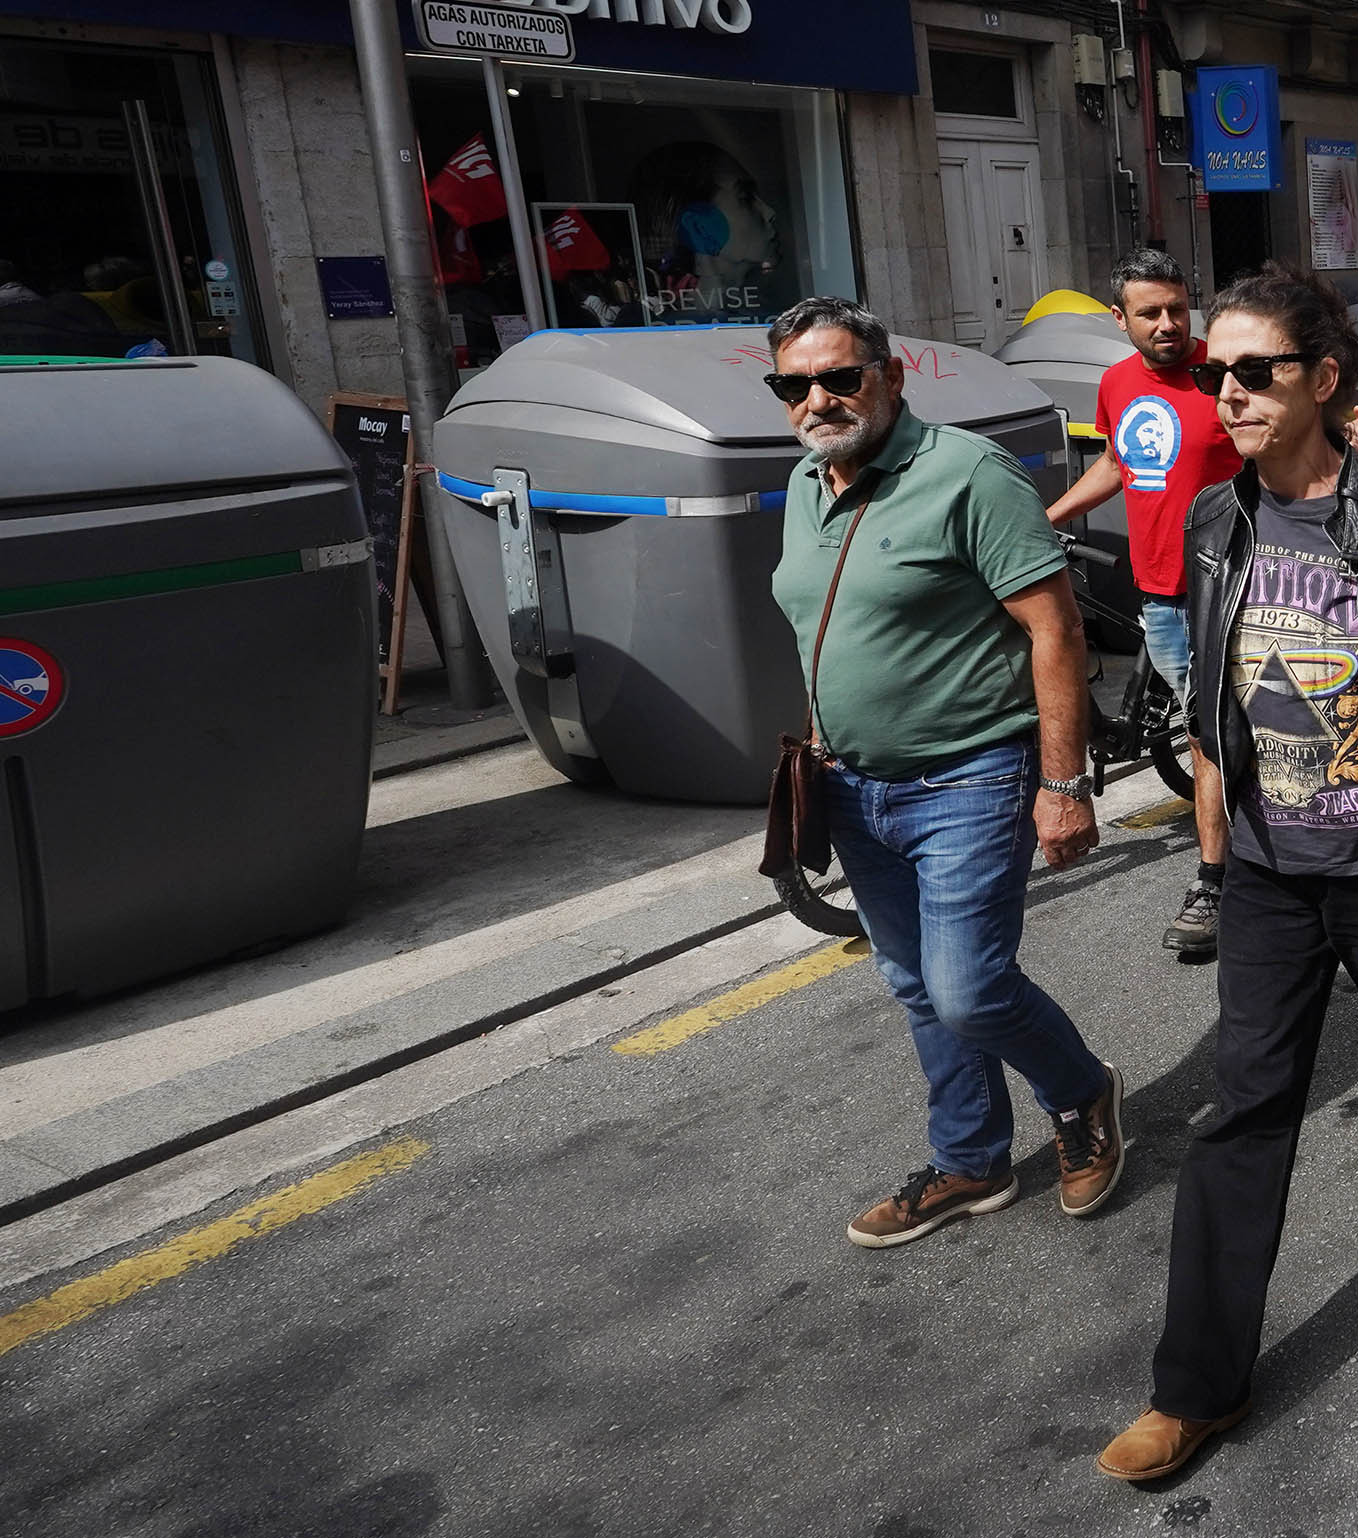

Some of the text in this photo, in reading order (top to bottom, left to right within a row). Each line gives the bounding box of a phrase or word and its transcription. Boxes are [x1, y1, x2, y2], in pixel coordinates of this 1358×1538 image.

[470, 9, 565, 35] AUTORIZADOS
[984, 14, 998, 25] 12
[456, 30, 548, 54] CON TARXETA
[1207, 150, 1267, 170] NOA NAILS
[657, 285, 761, 312] REVISE
[358, 416, 389, 438] Mocay
[1254, 543, 1276, 554] SIDE
[1277, 546, 1290, 555] OF
[1294, 551, 1314, 562] THE
[1258, 609, 1300, 629] 1973
[1256, 738, 1320, 760] ADIO CITY
